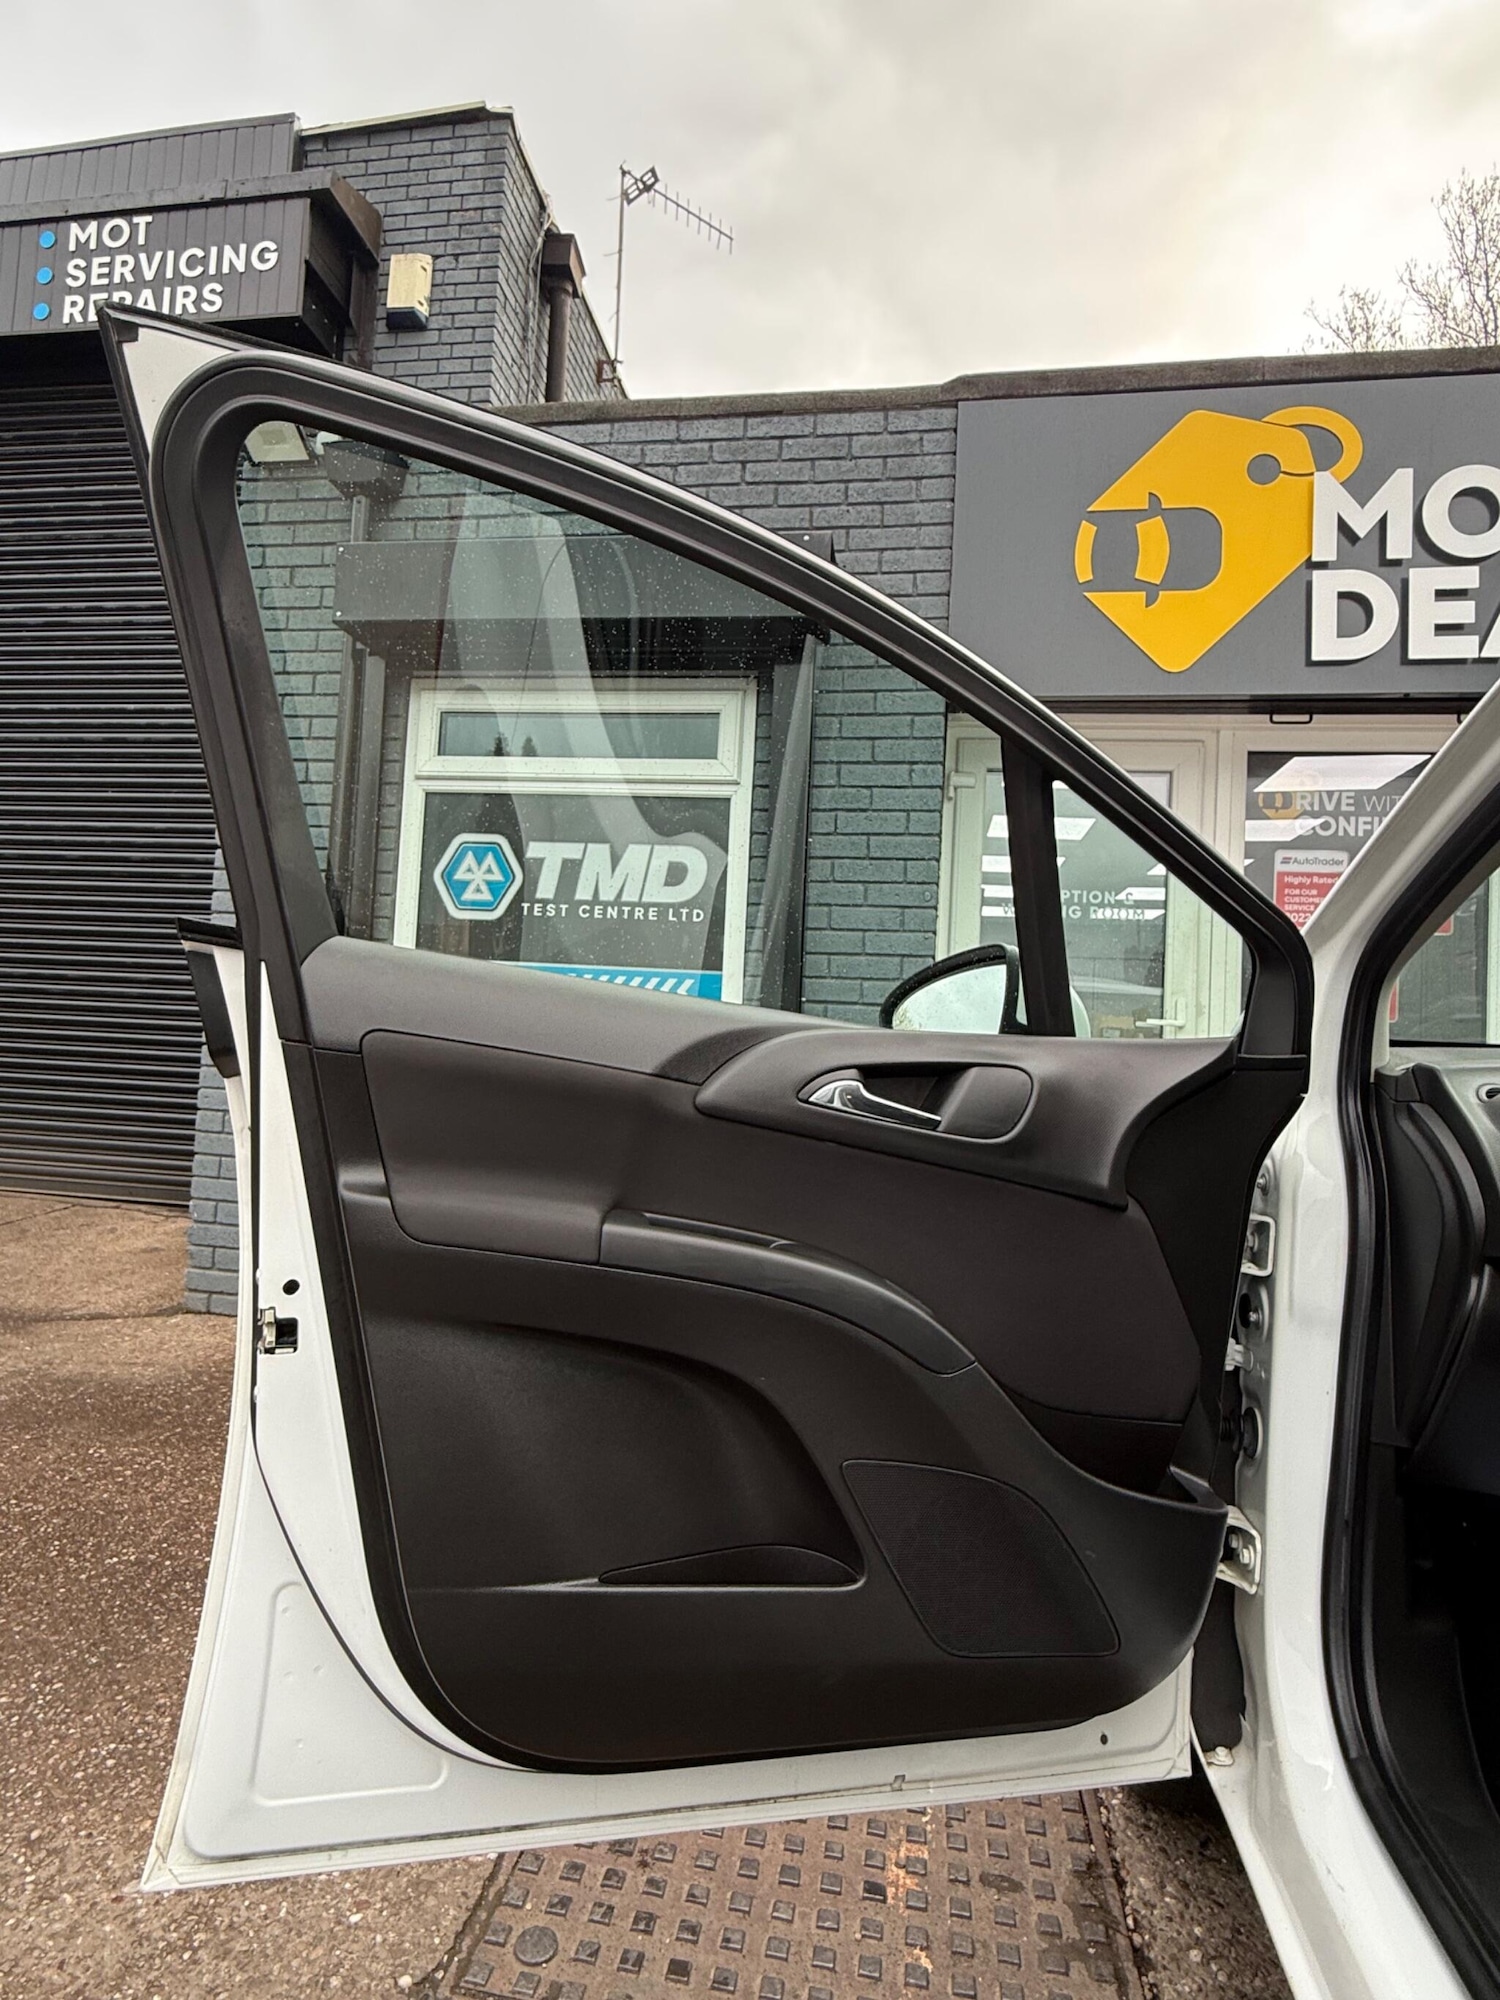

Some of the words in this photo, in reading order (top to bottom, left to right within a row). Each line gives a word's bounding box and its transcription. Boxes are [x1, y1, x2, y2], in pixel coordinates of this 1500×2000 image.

[68, 215, 153, 251] MOT
[65, 240, 279, 288] SERVICING
[1311, 464, 1500, 562] MO
[1311, 565, 1500, 662] DE
[1295, 815, 1387, 837] CONFI
[525, 841, 708, 903] TMD
[1292, 857, 1344, 866] AutoTrader
[1284, 875, 1311, 885] Highly
[1301, 888, 1318, 896] OUR
[521, 903, 569, 917] TEST
[578, 905, 658, 920] CENTRE
[668, 908, 705, 922] LTD
[1089, 905, 1145, 920] ROOM
